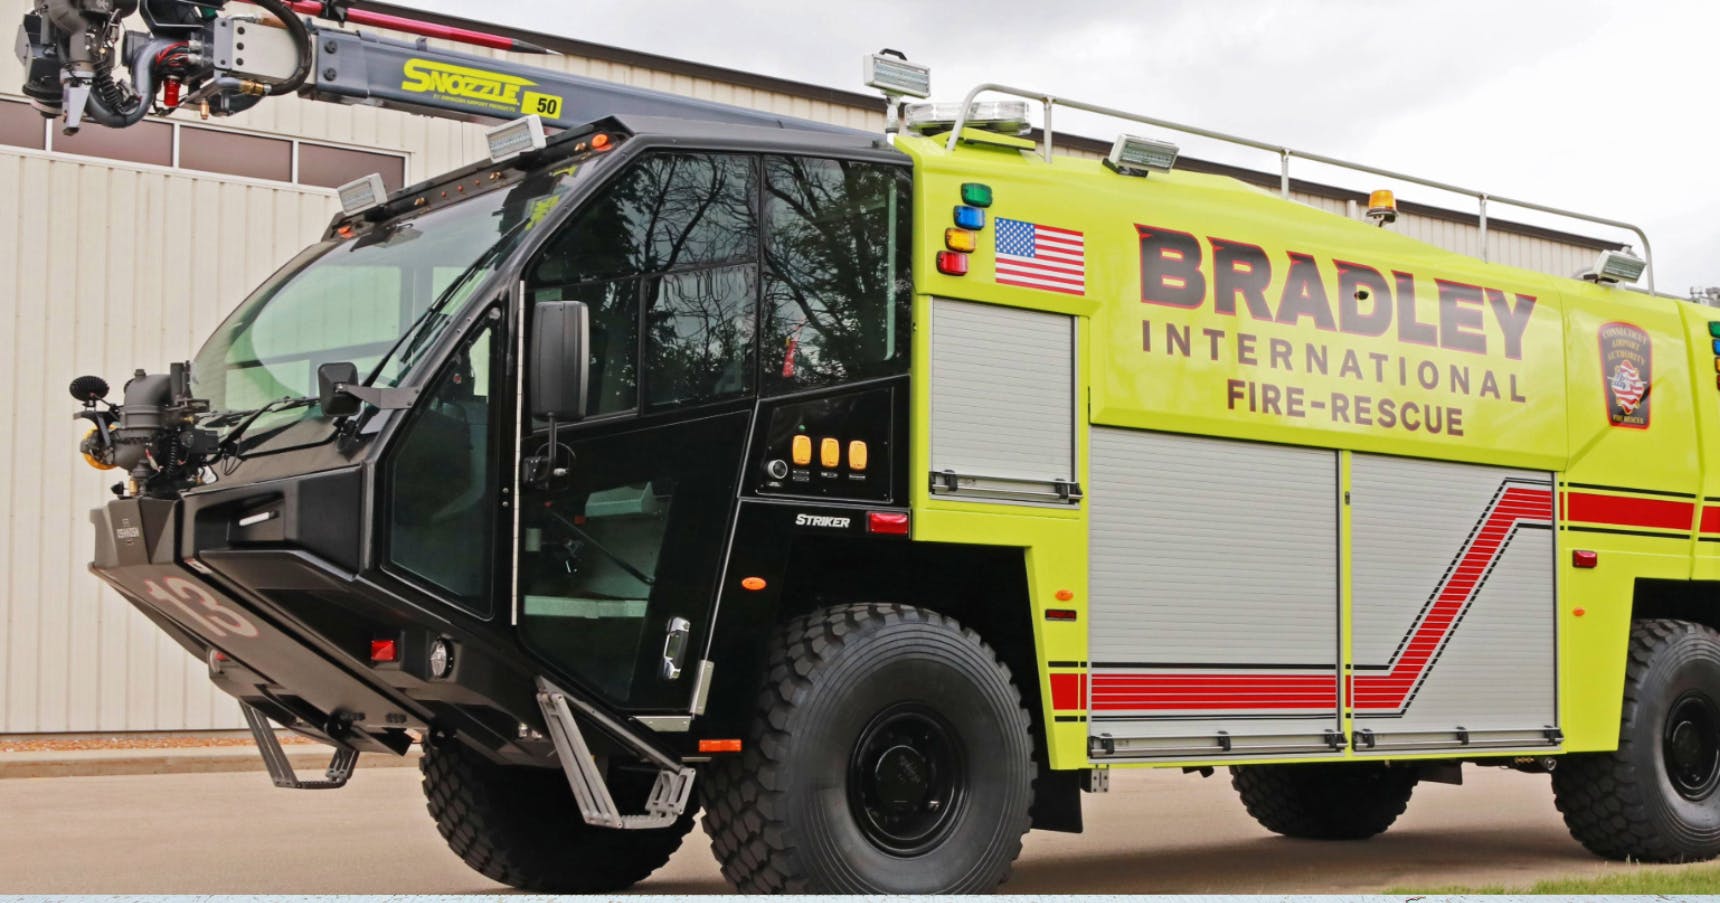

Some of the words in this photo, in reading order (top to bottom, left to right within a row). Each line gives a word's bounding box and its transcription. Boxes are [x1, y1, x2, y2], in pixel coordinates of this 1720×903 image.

[401, 58, 539, 105] SNOZZLE
[536, 97, 557, 115] 50
[1134, 223, 1537, 361] BRADLEY
[1141, 319, 1527, 403] INTERNATIONAL
[1227, 378, 1464, 437] FIRE-RESCUE
[795, 513, 850, 529] STRIKER
[143, 575, 260, 638] 13
